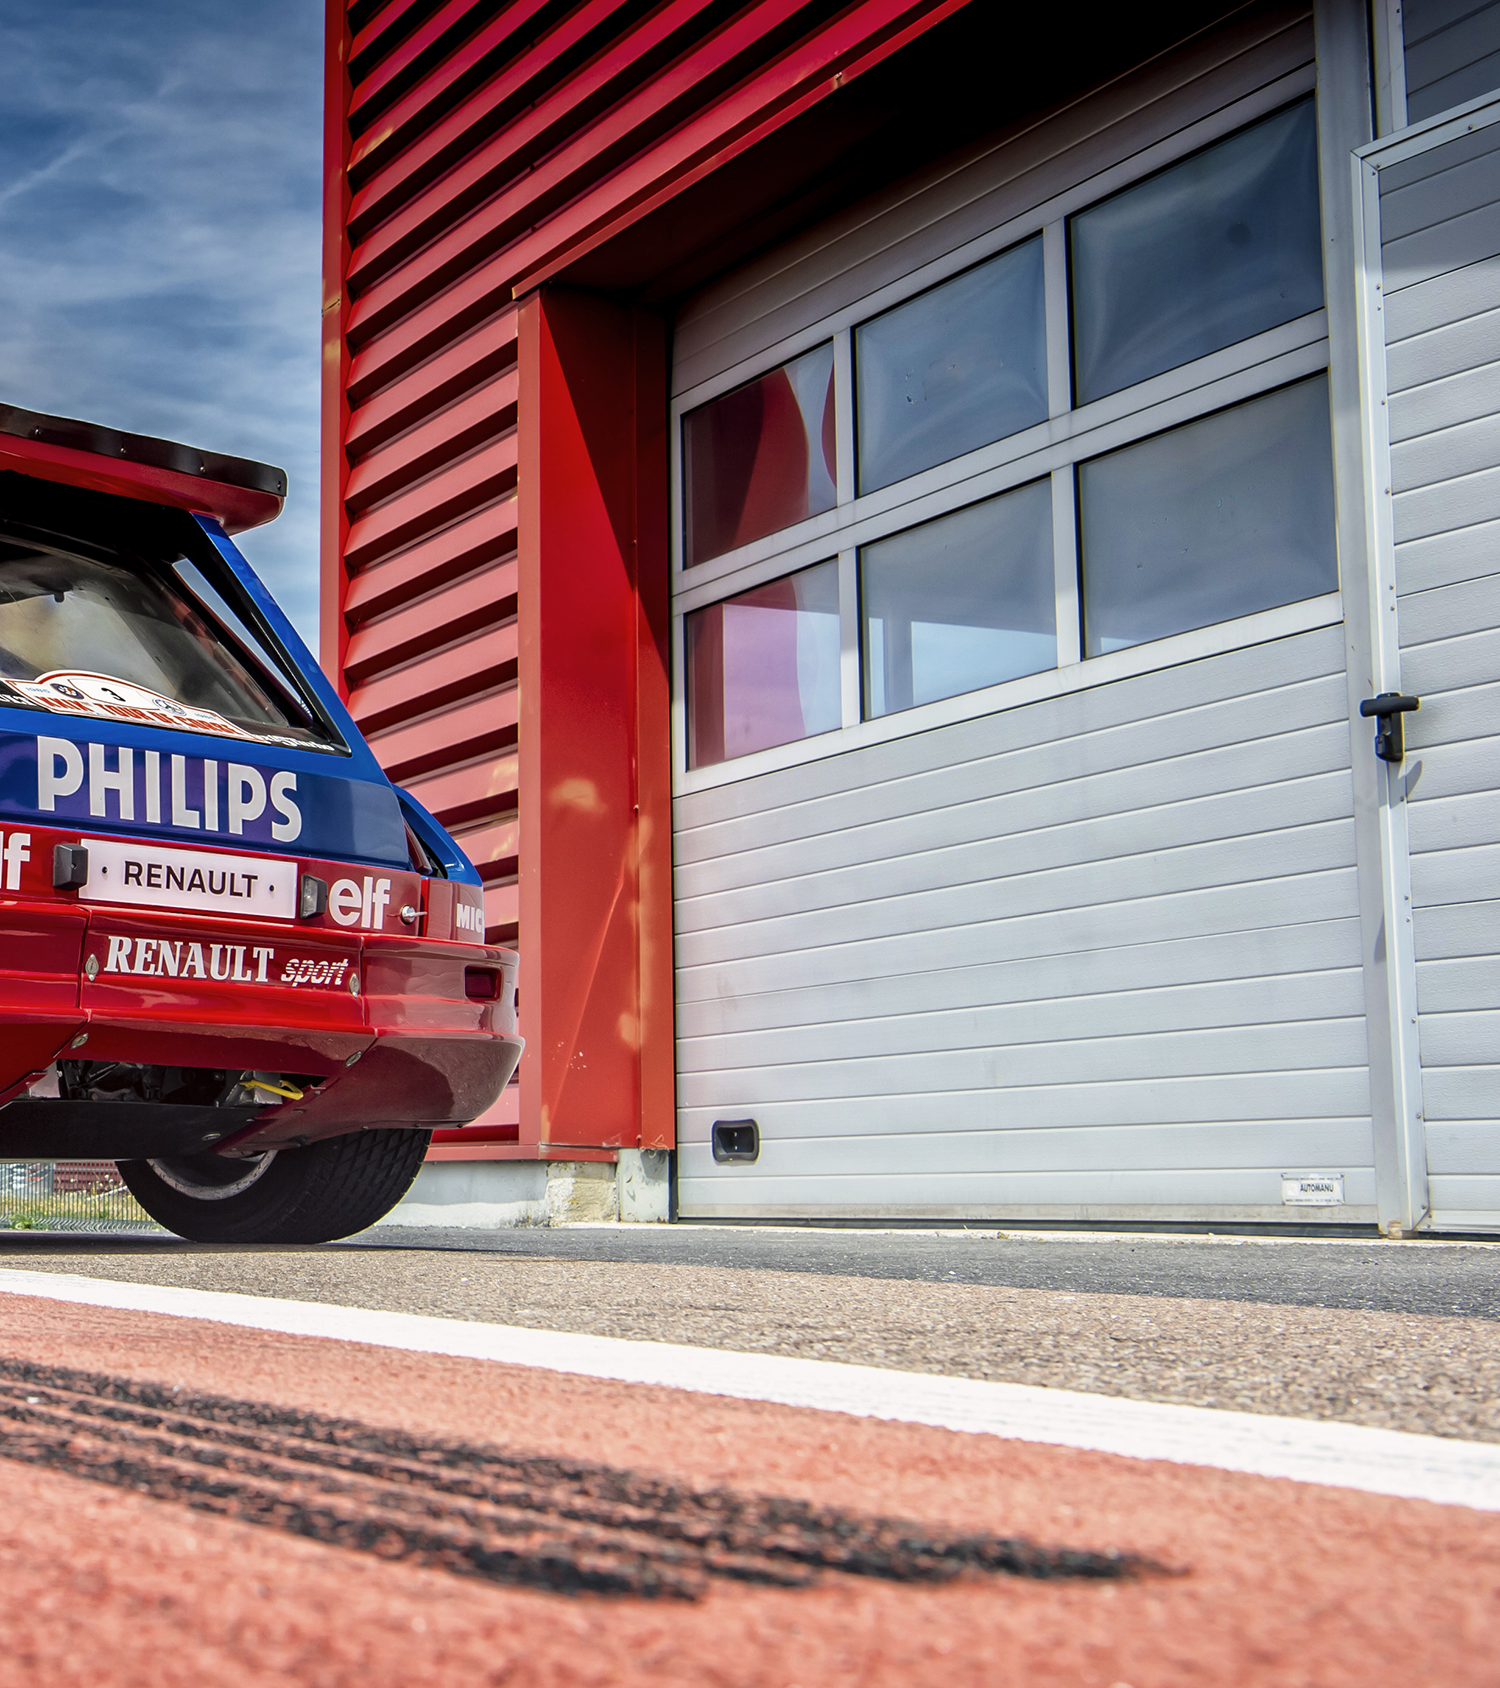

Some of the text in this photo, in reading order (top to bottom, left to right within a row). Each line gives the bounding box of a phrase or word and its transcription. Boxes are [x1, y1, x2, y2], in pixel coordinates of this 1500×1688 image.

[37, 734, 303, 843] PHILIPS
[124, 860, 259, 899] RENAULT
[328, 876, 391, 930] elf
[103, 935, 349, 987] RENAULT sport
